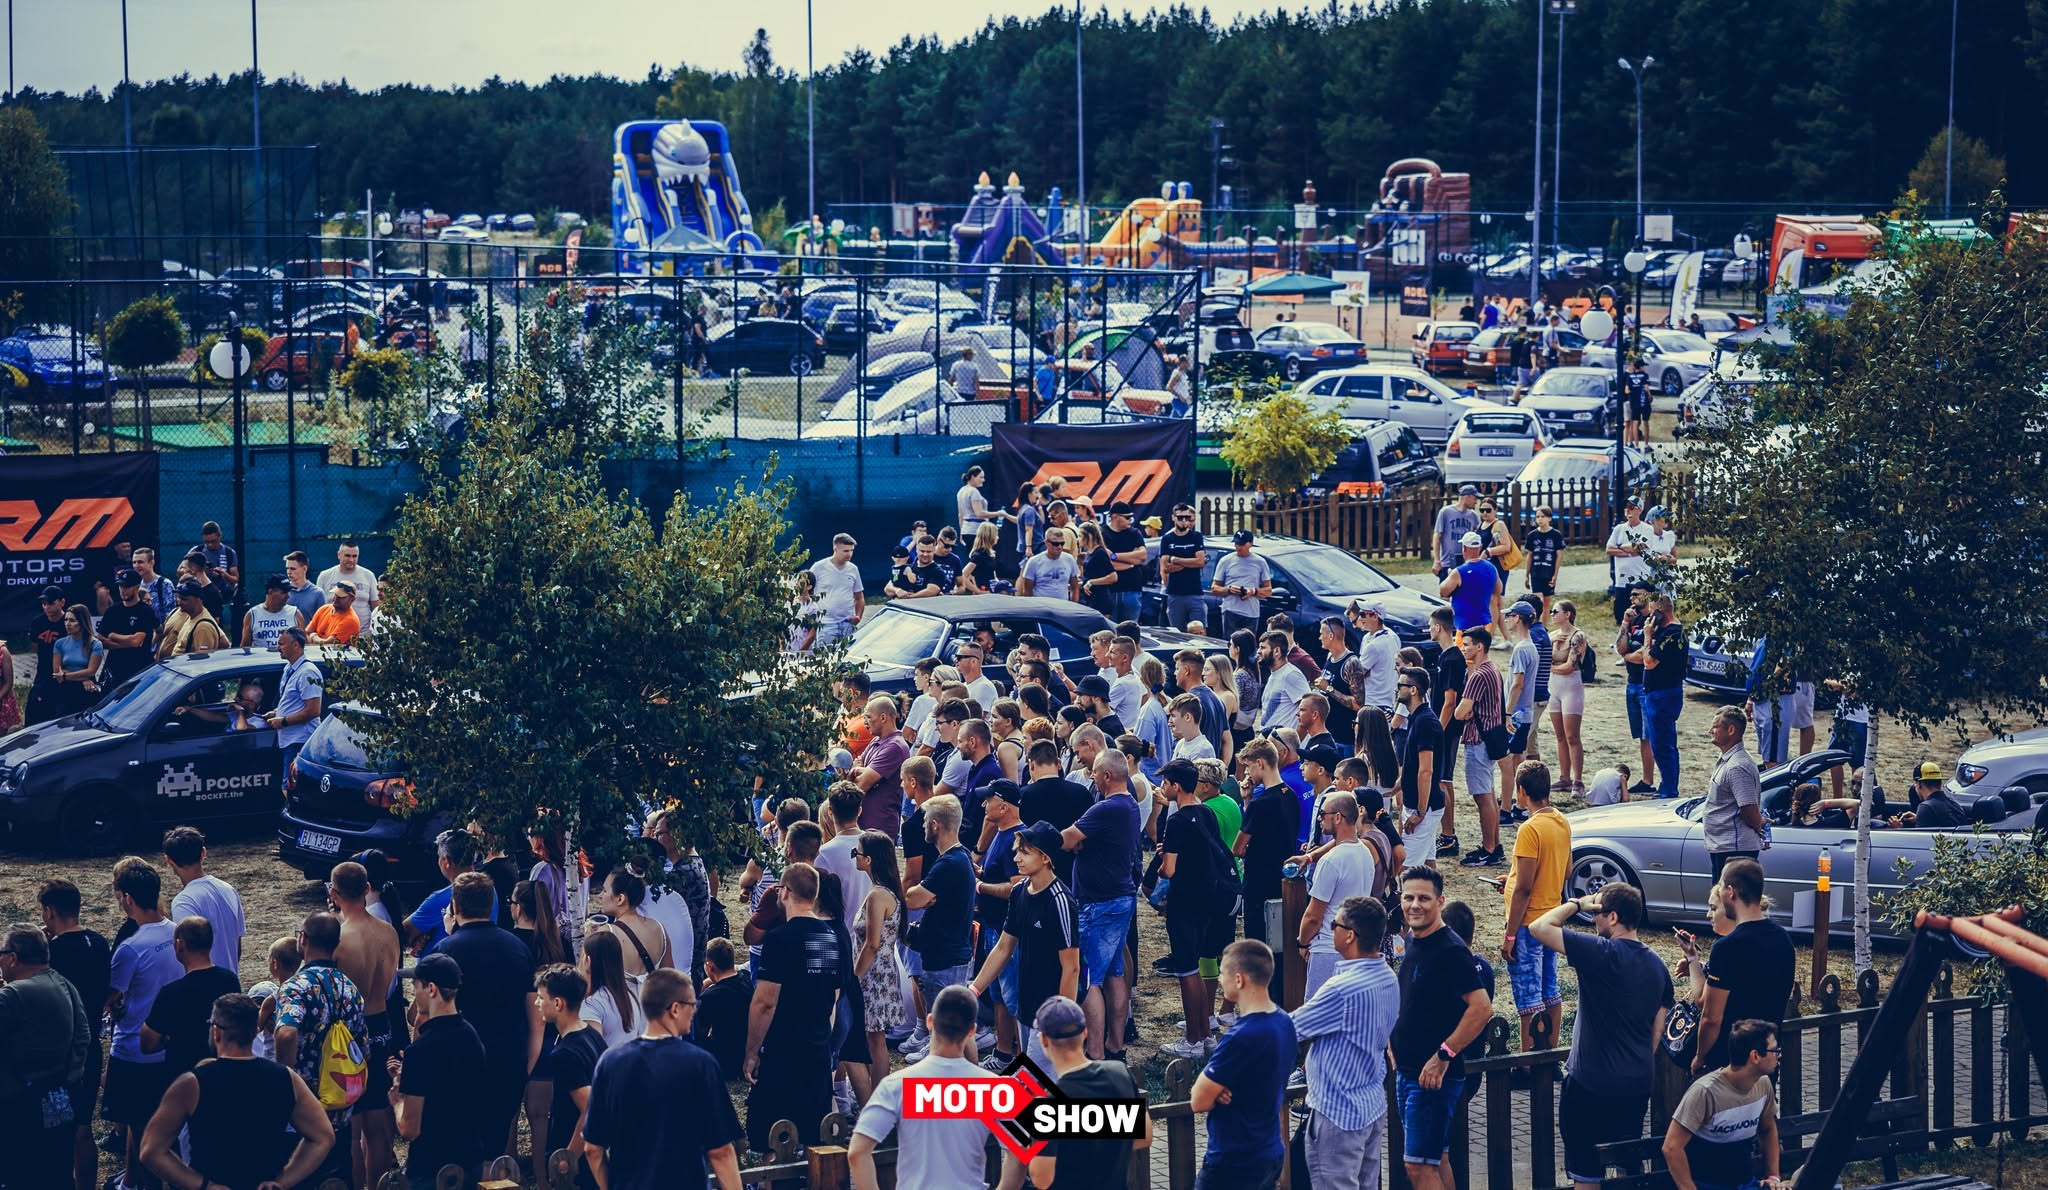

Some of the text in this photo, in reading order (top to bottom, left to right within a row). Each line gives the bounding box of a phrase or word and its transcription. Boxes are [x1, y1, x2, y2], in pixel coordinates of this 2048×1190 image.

[0, 558, 85, 574] TORS
[7, 575, 72, 586] DRIVE US
[258, 619, 289, 628] TRAVEL
[257, 630, 280, 639] AROU
[206, 773, 272, 791] POCKET
[314, 834, 339, 850] 134GP
